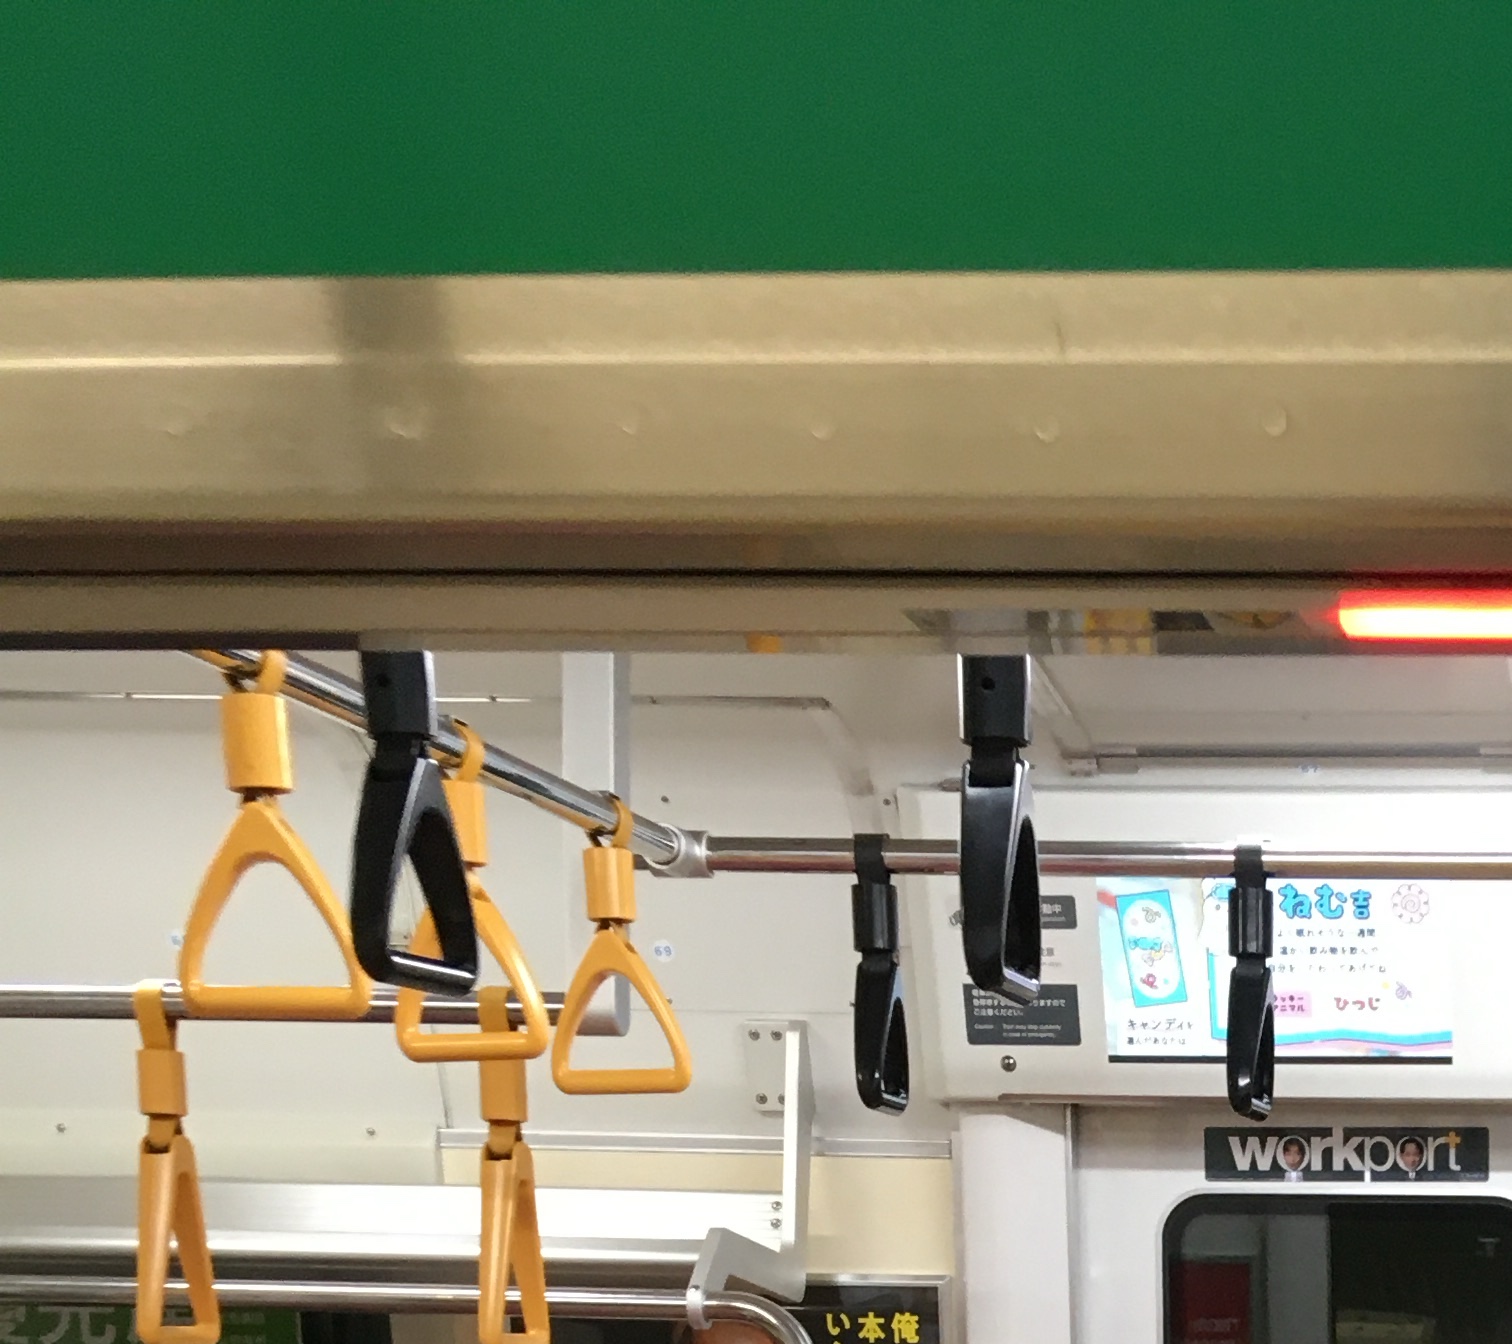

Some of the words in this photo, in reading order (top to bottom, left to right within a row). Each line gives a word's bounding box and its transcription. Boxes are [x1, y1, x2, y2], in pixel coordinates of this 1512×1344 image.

[1277, 884, 1373, 920] ねむ吉
[1333, 996, 1381, 1011] ひつじ
[1228, 1130, 1461, 1173] workport
